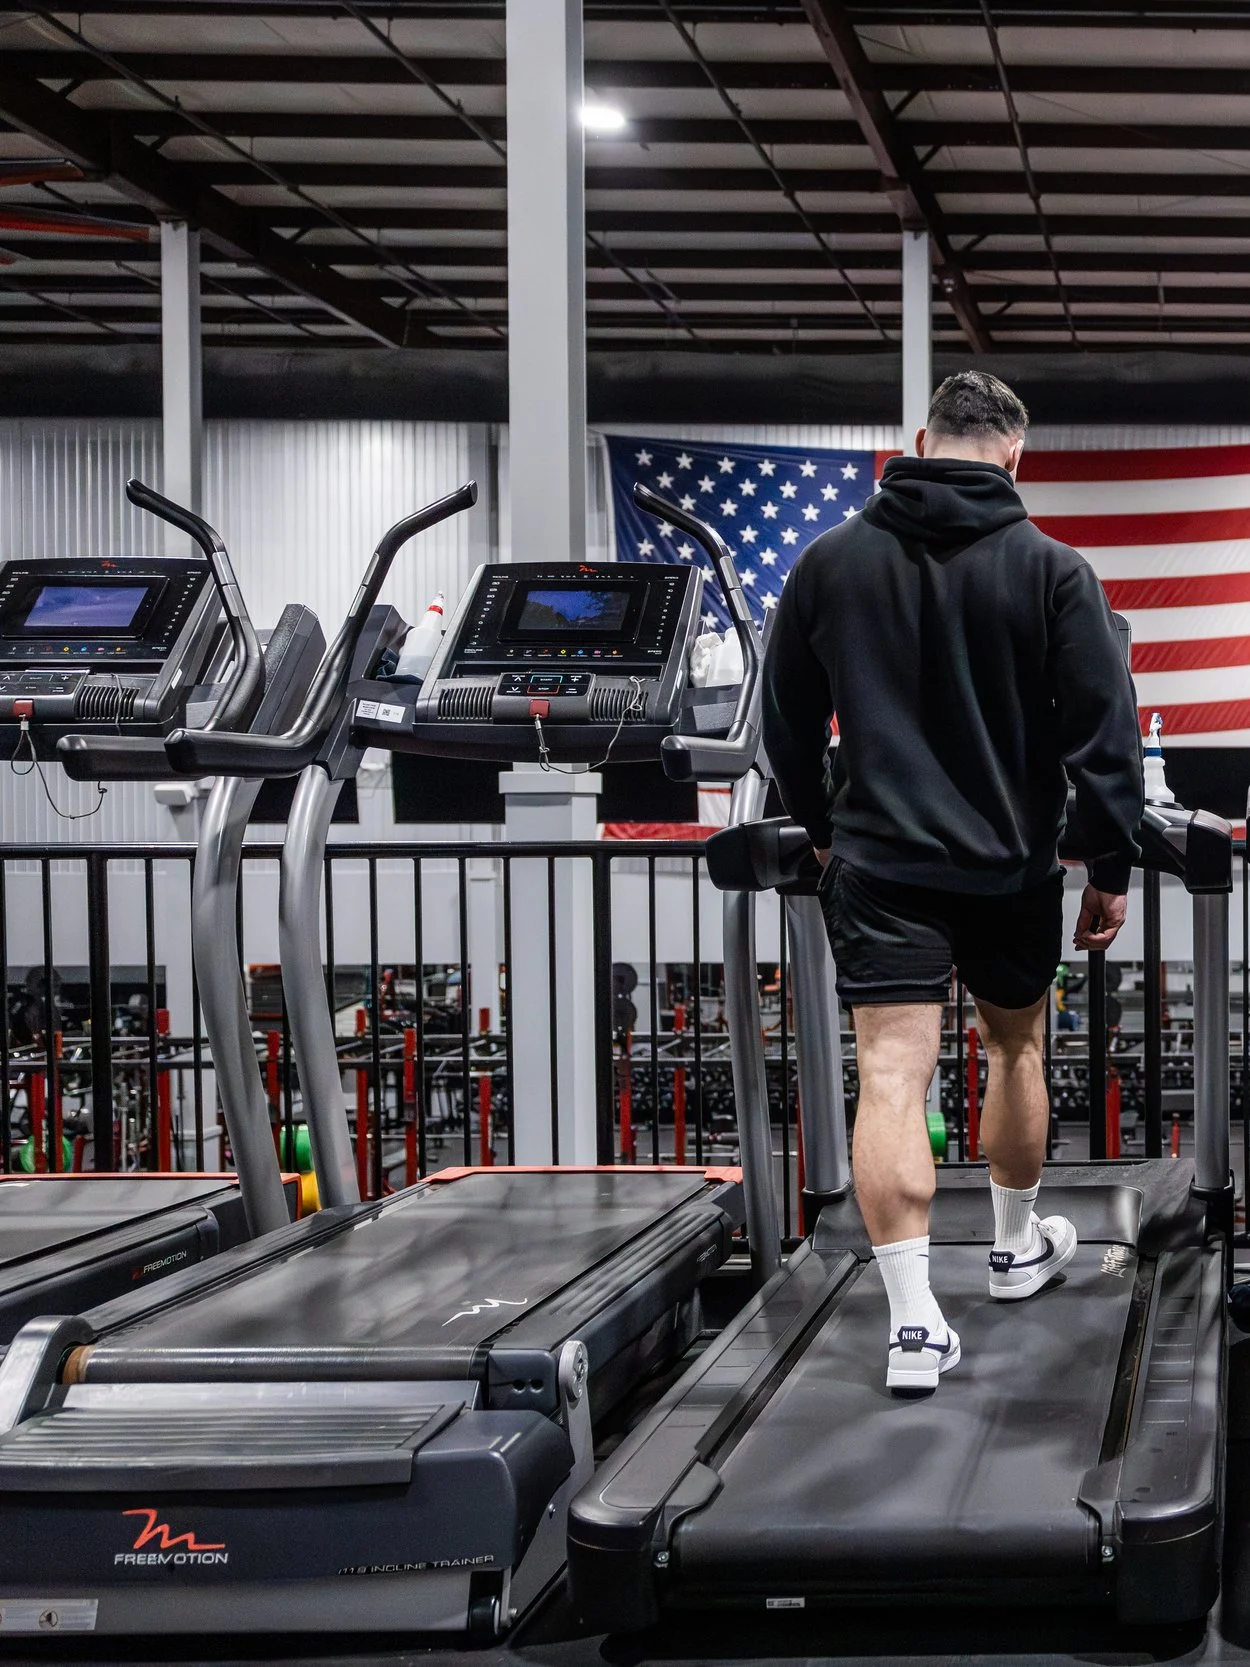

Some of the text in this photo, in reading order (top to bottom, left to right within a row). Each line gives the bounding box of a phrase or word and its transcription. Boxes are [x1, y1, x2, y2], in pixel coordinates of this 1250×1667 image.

[143, 1250, 187, 1274] FREEMOTION
[992, 1255, 1009, 1264] NIKE
[902, 1330, 923, 1340] NIKE
[432, 1554, 495, 1569] TRAINER
